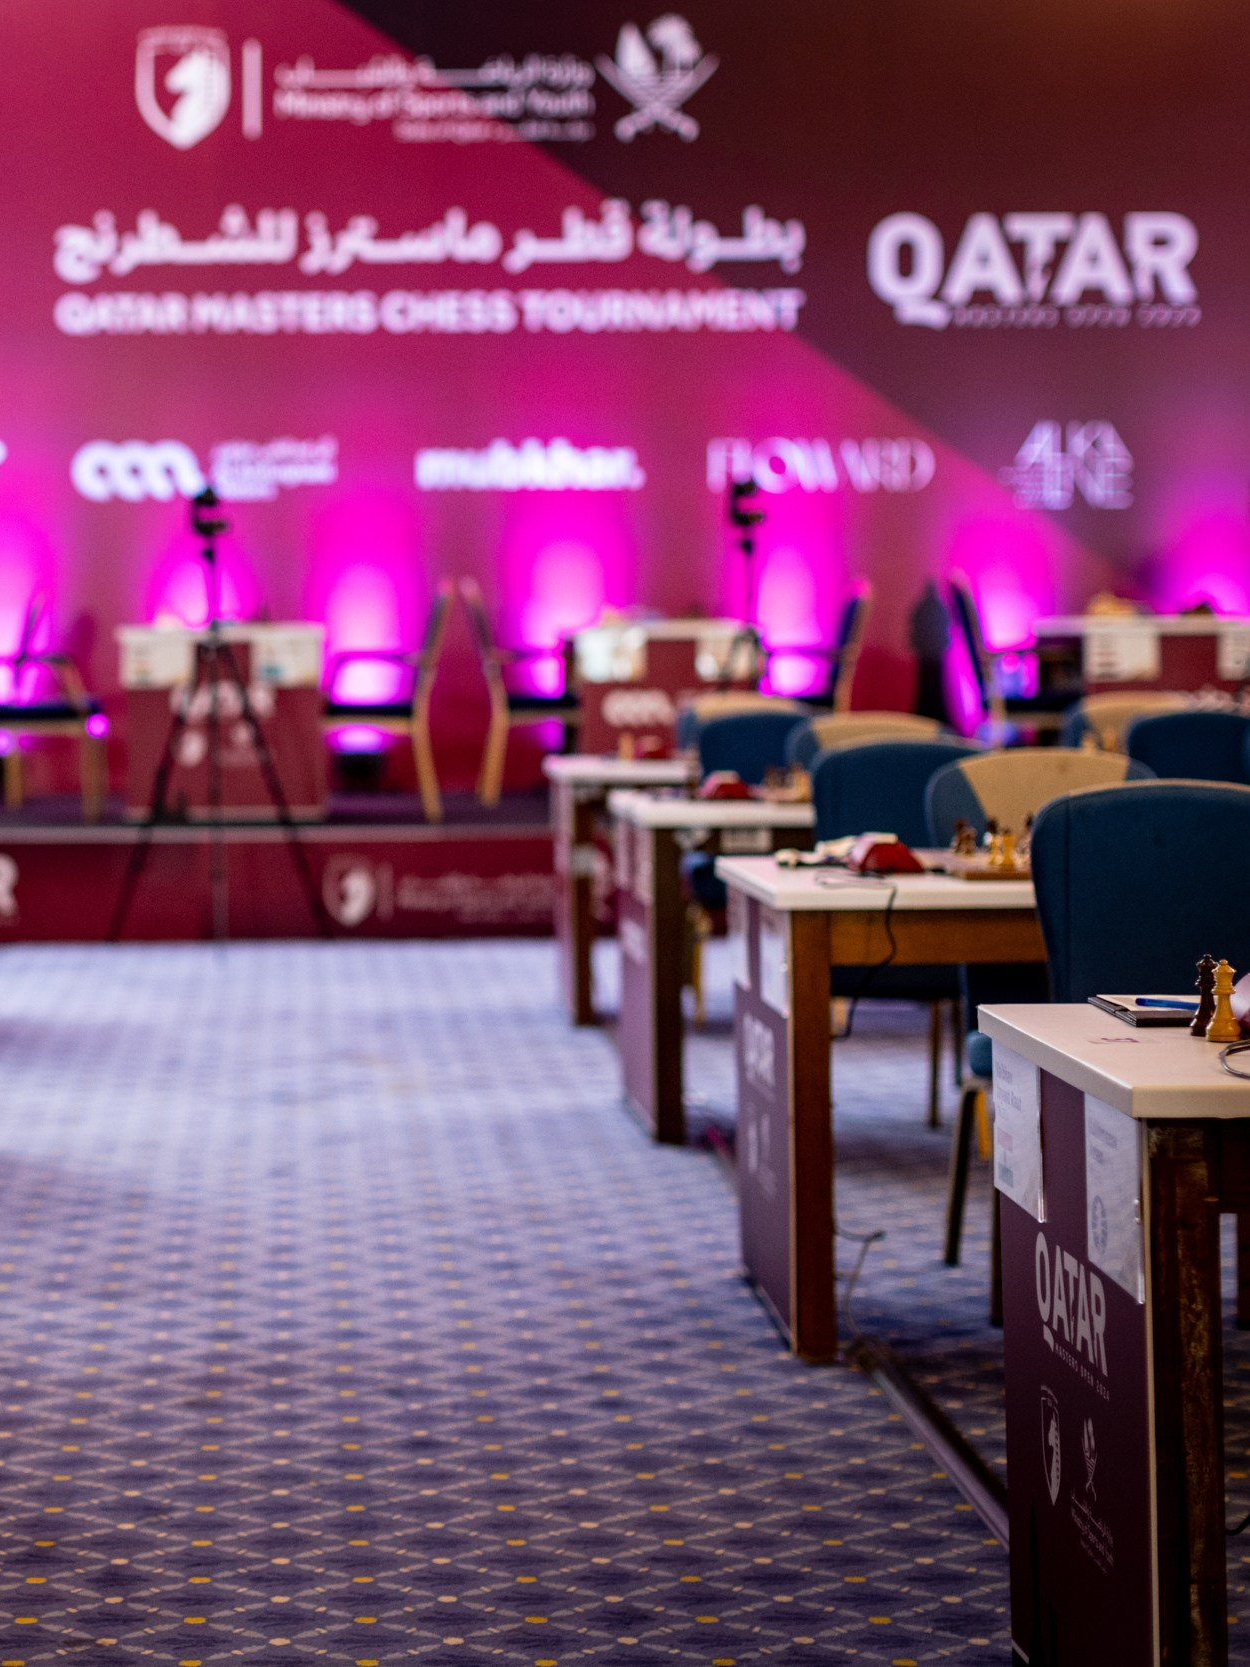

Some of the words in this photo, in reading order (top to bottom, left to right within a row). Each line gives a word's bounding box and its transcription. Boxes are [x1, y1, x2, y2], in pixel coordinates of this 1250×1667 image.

[867, 211, 1199, 330] QATAR
[1035, 1232, 1108, 1377] QATAR
[1055, 1342, 1078, 1373] MASTERS
[1080, 1364, 1094, 1387] OPEN
